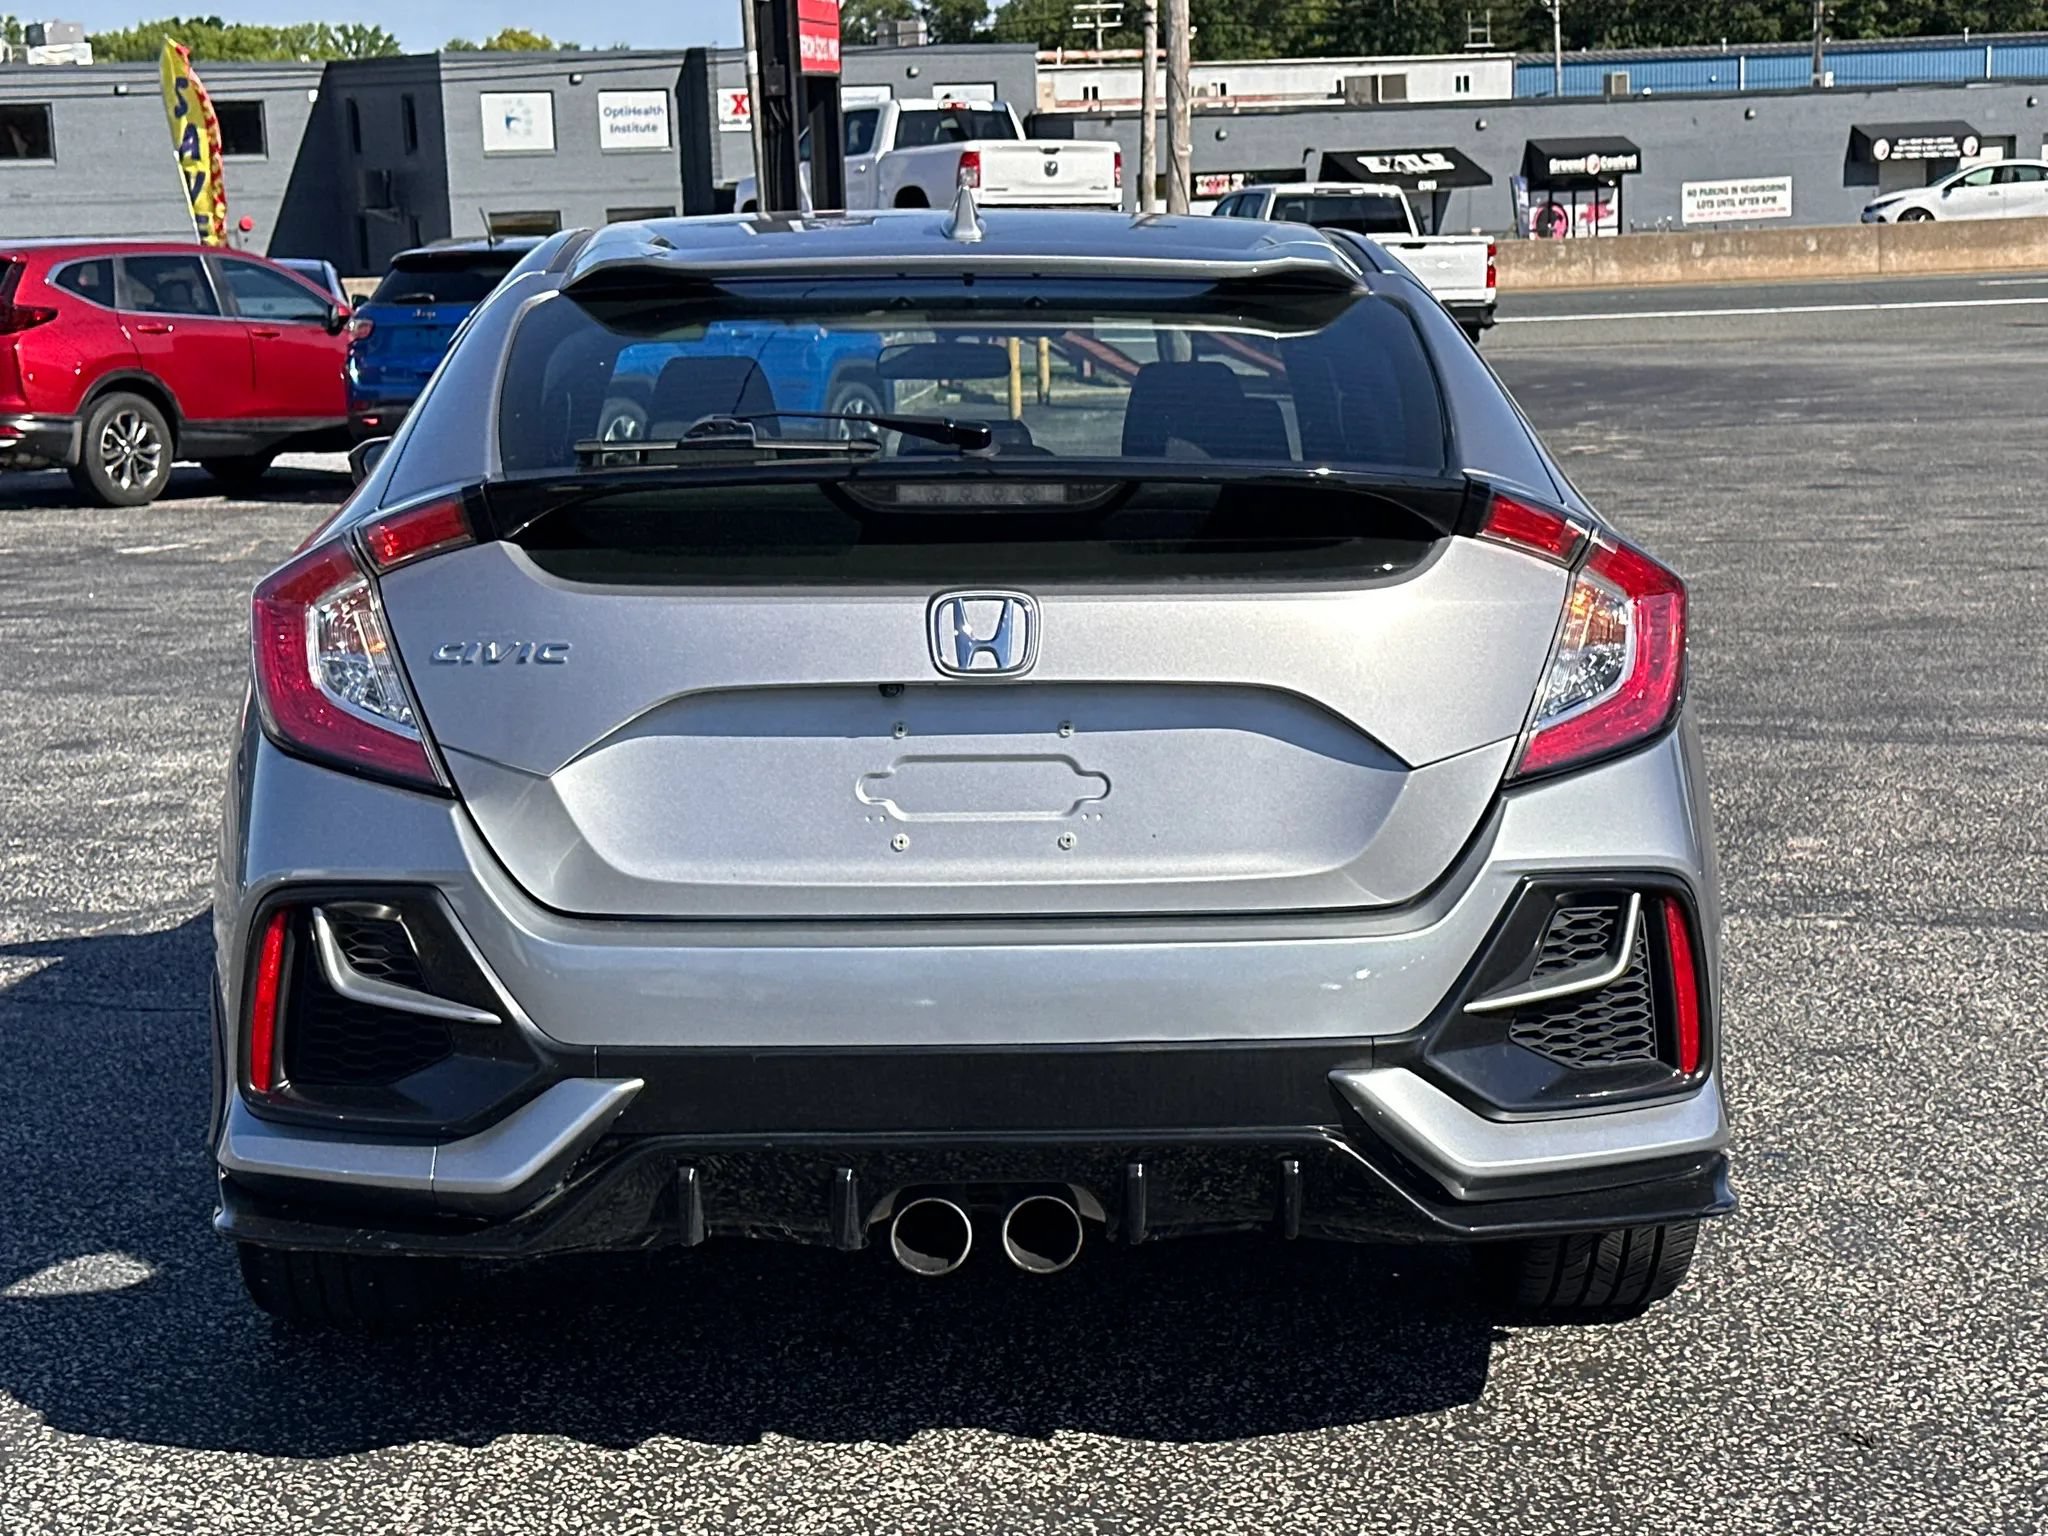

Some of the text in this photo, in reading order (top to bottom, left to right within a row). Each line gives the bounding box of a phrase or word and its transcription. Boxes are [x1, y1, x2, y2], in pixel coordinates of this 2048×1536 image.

[603, 104, 664, 119] OptiHealth
[610, 121, 658, 133] Institute
[1687, 189, 1697, 198] NO
[1699, 186, 1729, 197] PARKING
[1731, 186, 1738, 196] IN
[1696, 198, 1715, 210] LOTS
[1717, 198, 1736, 208] UNTIL
[1739, 196, 1760, 206] AFTER
[431, 641, 572, 665] CIVIC
